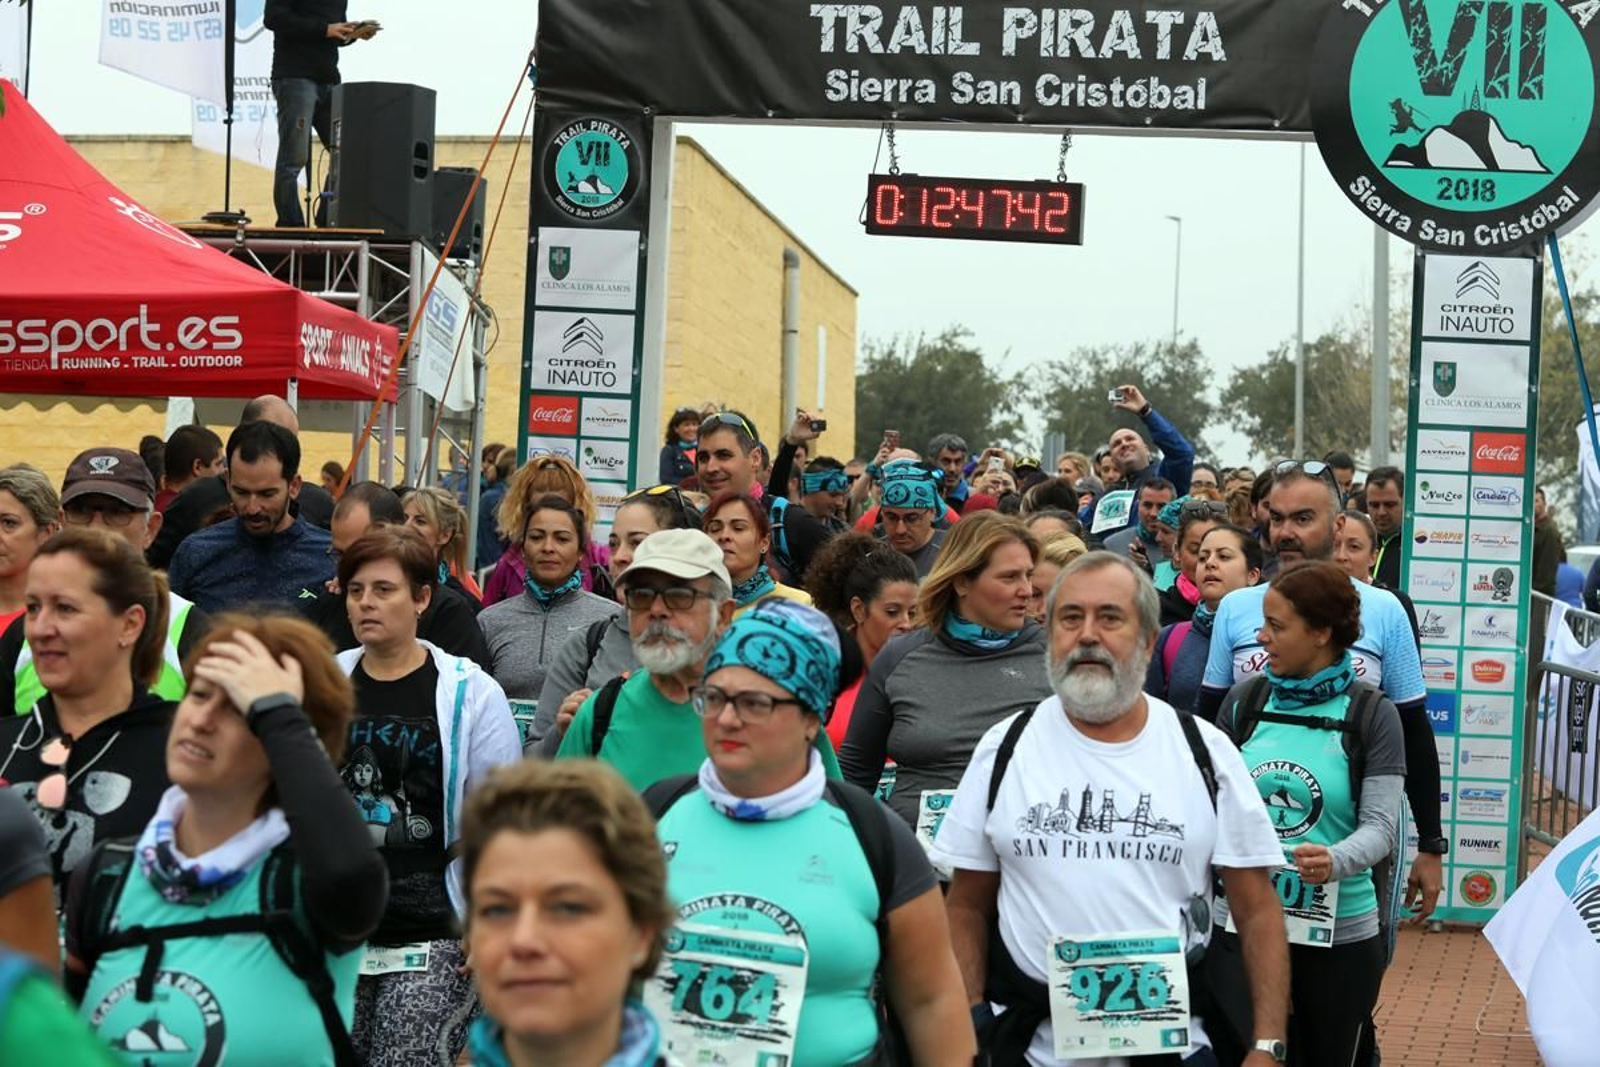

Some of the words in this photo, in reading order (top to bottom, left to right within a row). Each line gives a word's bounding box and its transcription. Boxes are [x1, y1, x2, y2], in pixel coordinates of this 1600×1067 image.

[810, 3, 980, 56] TRAIL
[1001, 7, 1227, 62] PIRATA
[825, 69, 936, 104] Sierra
[950, 71, 1021, 106] San
[1035, 73, 1206, 111] Cristóbal
[554, 122, 587, 147] TRAIL
[590, 120, 632, 150] PIRATA
[1437, 177, 1496, 202] 2018
[1349, 175, 1412, 233] Sierra
[1418, 219, 1465, 246] San
[1474, 185, 1581, 245] Cristóbal
[1440, 316, 1514, 334] INAUTO
[4, 358, 49, 371] TIENDA
[62, 356, 120, 370] RUNNING
[132, 356, 169, 368] TRAIL
[180, 354, 243, 368] OUTDOOR
[547, 369, 617, 388] INAUTO
[1251, 761, 1290, 779] MINATA
[1012, 838, 1048, 858] SAN
[1061, 839, 1184, 866] FRANCISCO
[1459, 838, 1501, 849] RUNNEK
[680, 896, 746, 919] MINATA
[752, 898, 799, 936] PIRAT
[671, 958, 777, 1026] 764
[1070, 961, 1169, 1012] 926
